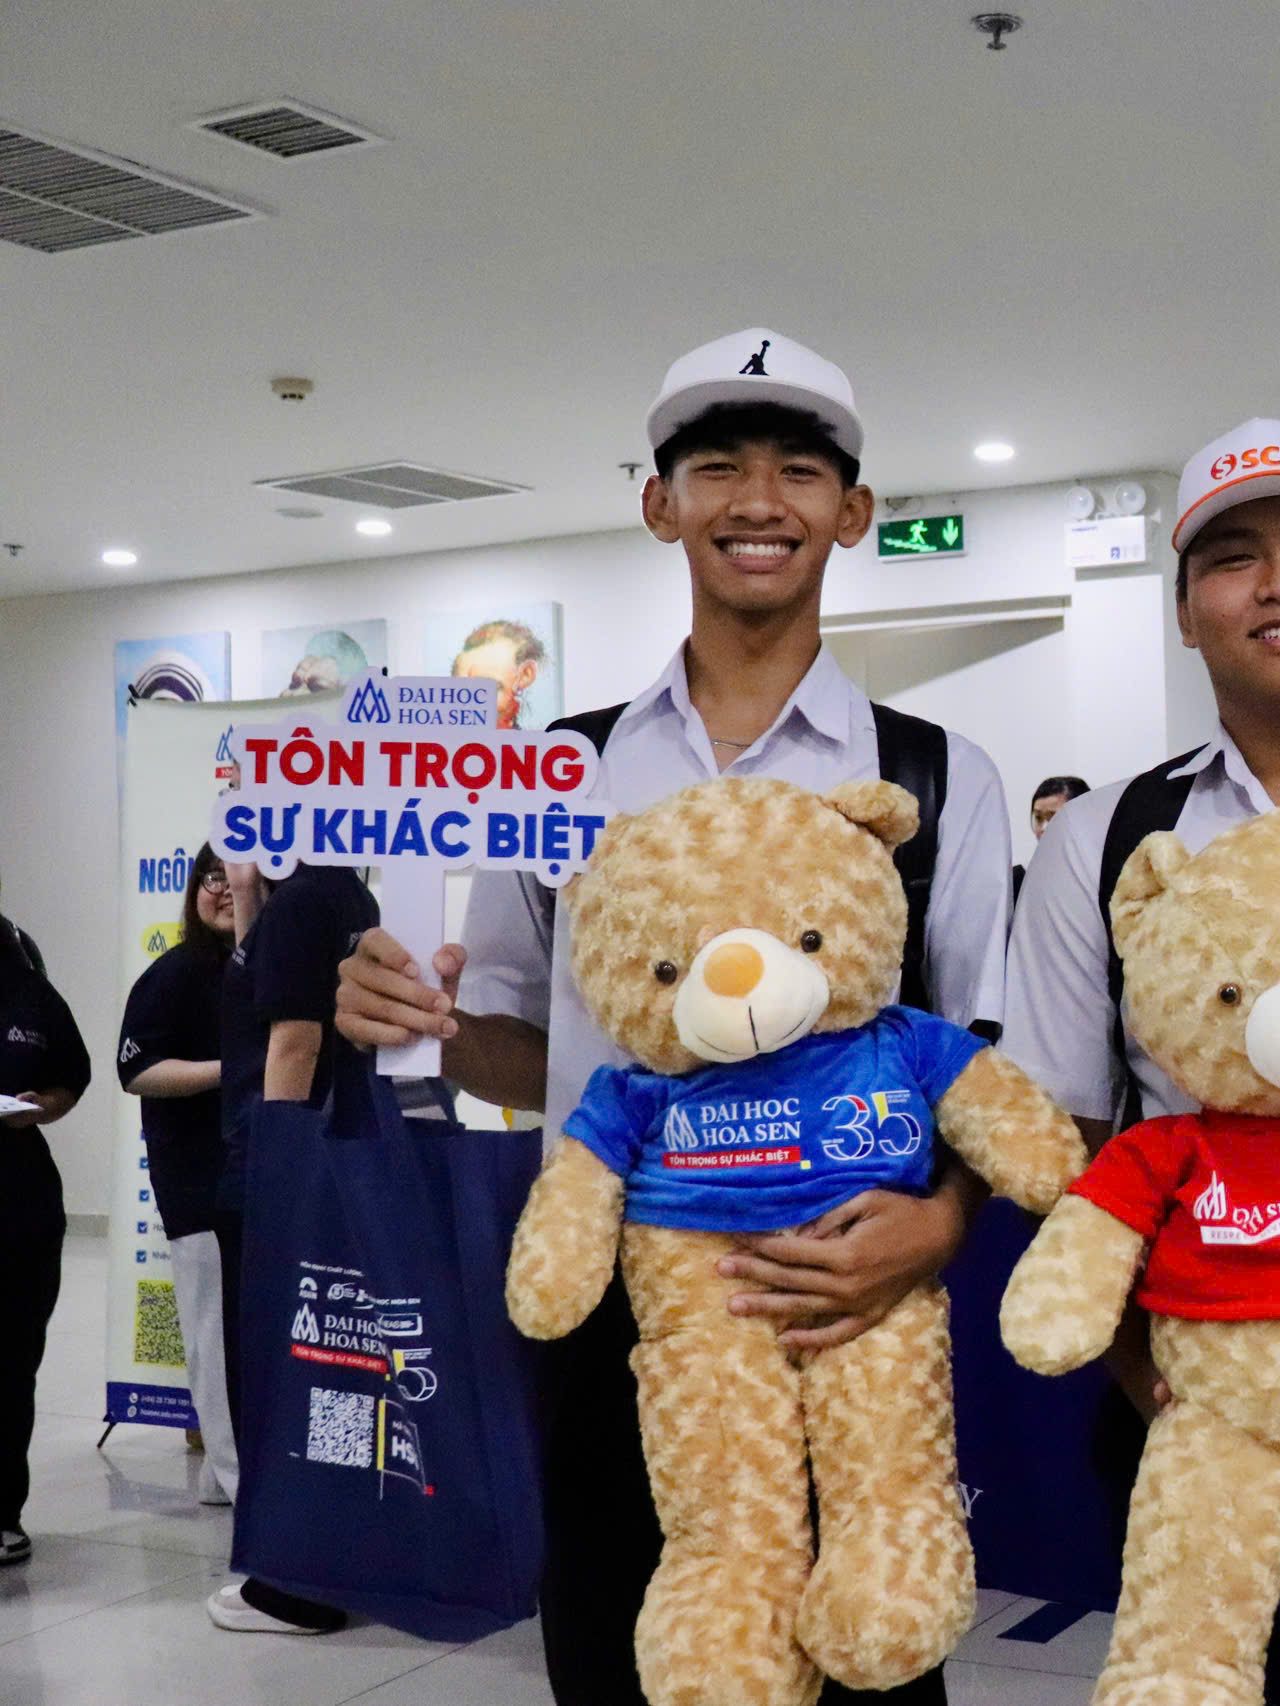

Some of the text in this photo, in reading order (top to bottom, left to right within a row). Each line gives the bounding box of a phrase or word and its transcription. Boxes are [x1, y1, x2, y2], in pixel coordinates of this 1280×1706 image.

[398, 708, 488, 726] HOA SEN
[245, 727, 585, 804] TÔN TRỌNG
[224, 798, 606, 876] SỰ KHÁC BIỆT
[702, 1121, 801, 1146] HOA SEN
[323, 1332, 360, 1351] HOA
